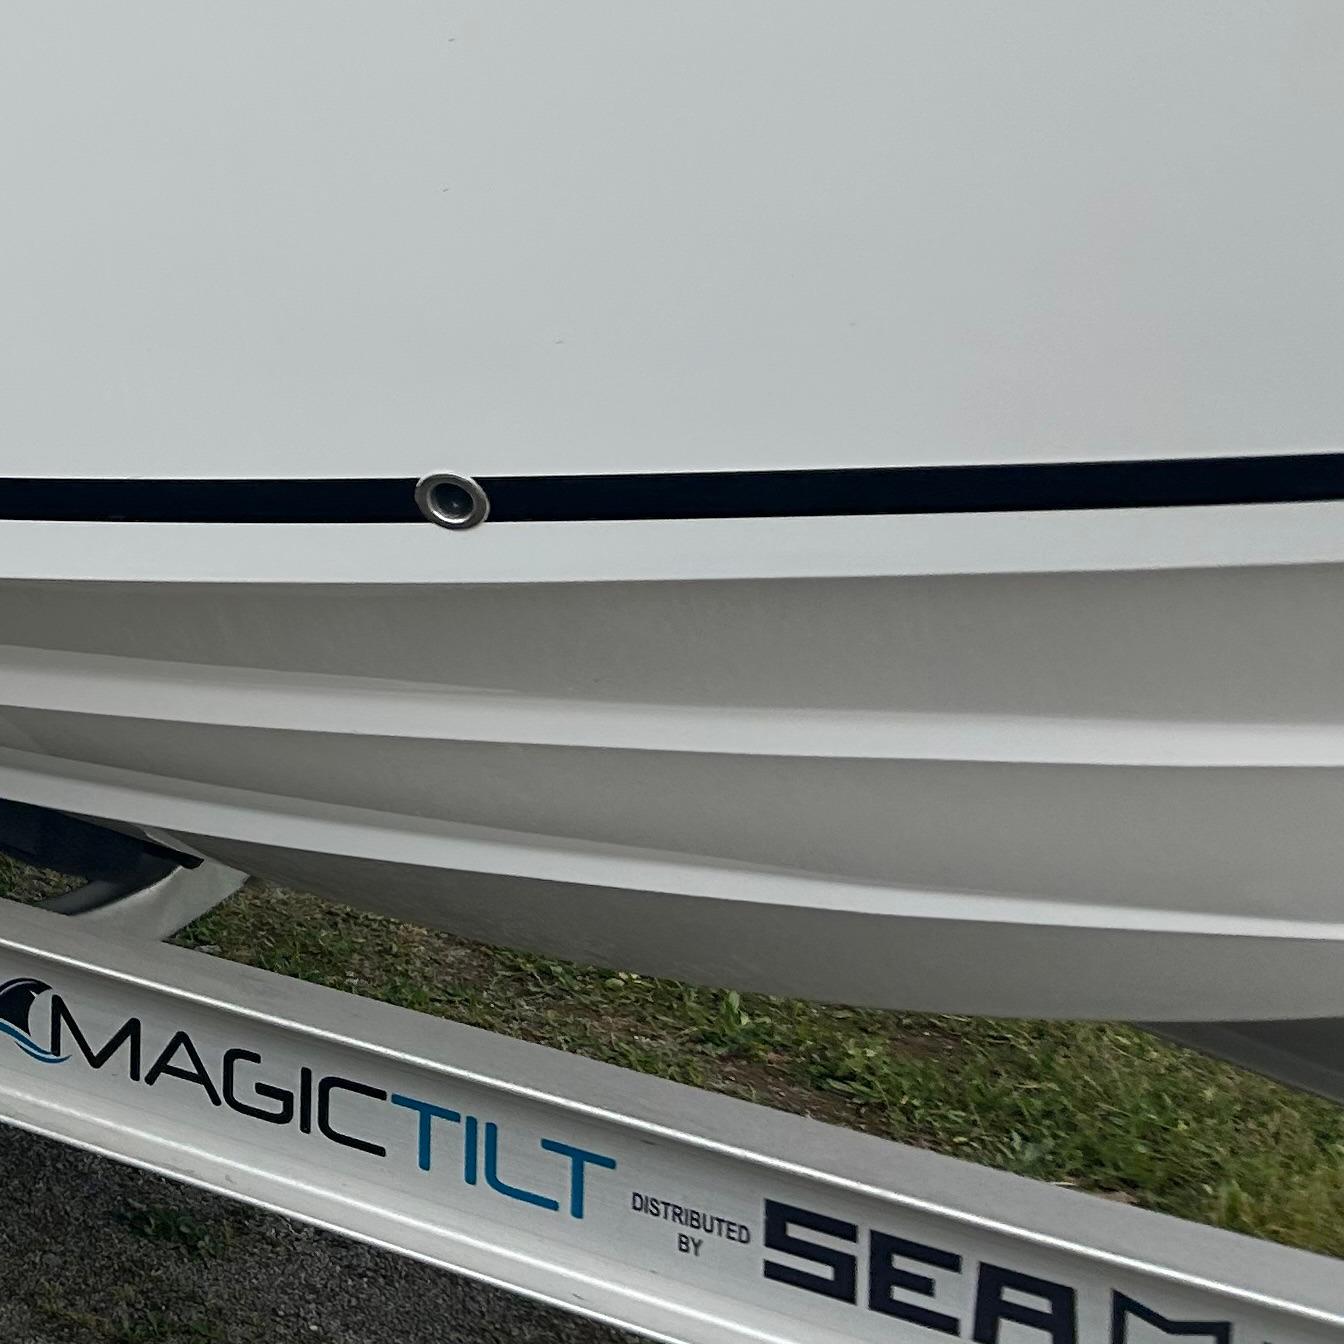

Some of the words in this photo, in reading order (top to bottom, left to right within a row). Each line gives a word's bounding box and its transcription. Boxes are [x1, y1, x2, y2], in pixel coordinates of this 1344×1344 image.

[50, 993, 616, 1220] MAGICTILT
[631, 1191, 751, 1245] DISTRIBUTED
[677, 1232, 703, 1256] BY
